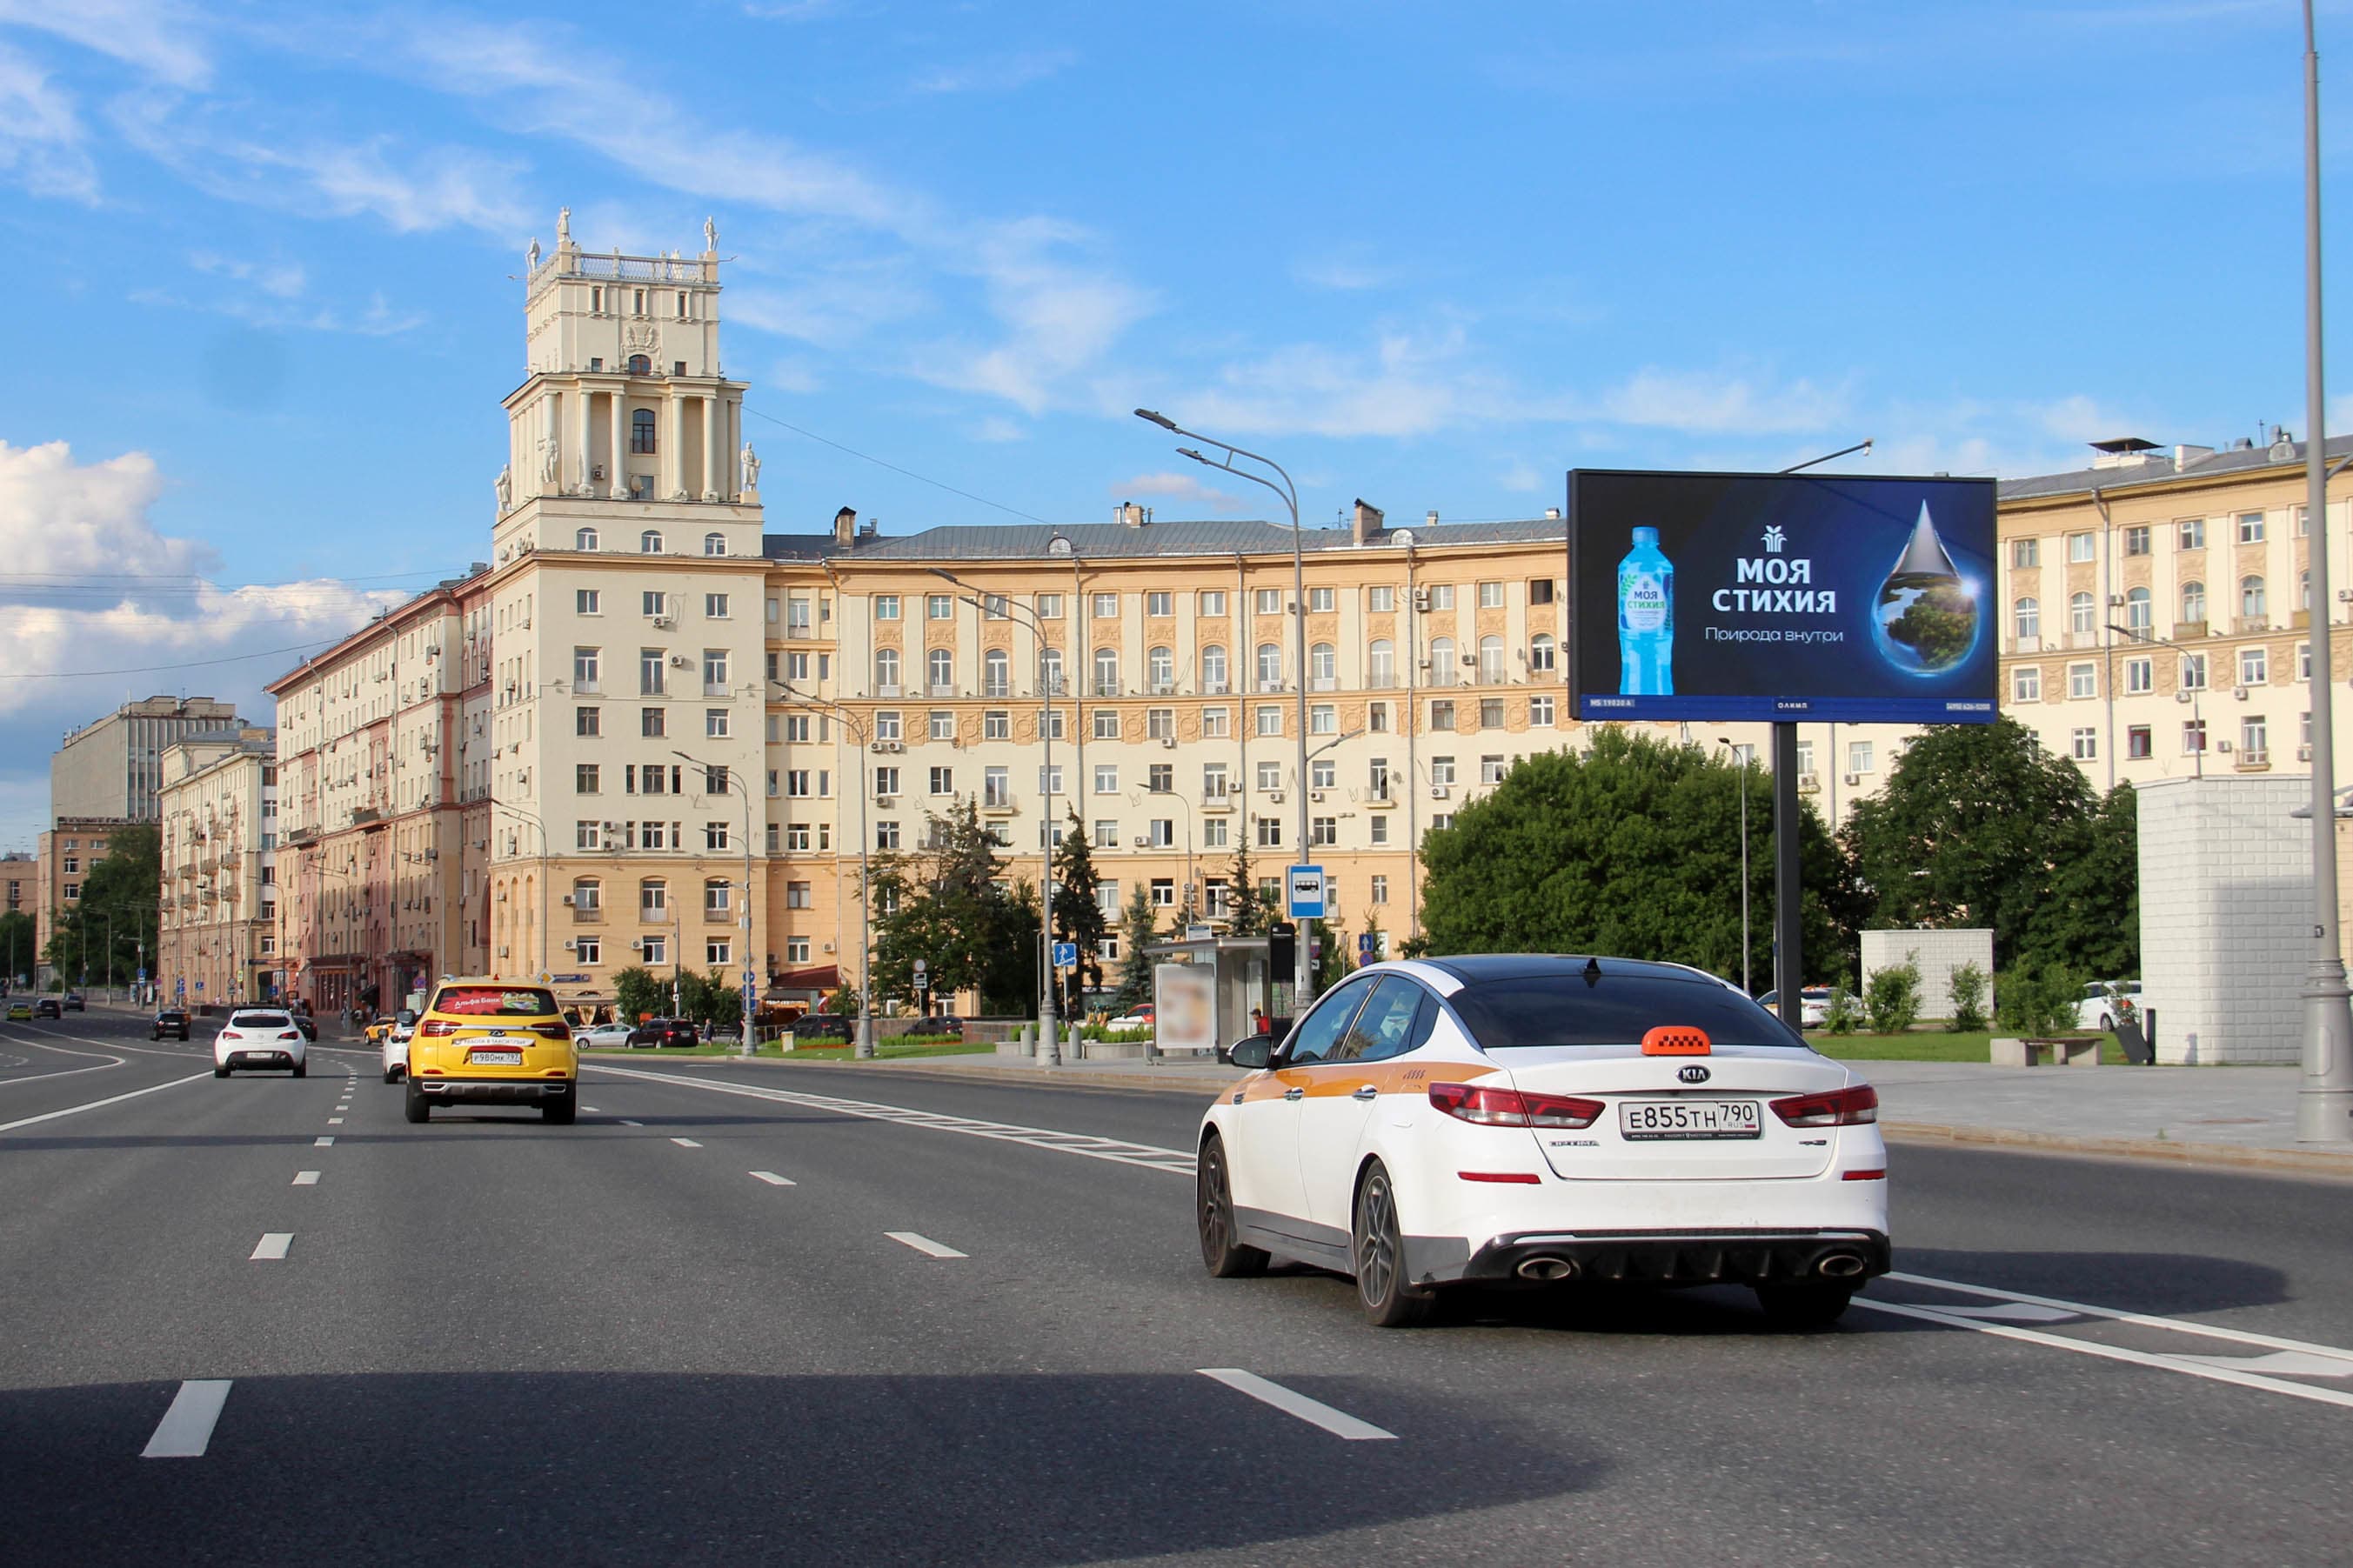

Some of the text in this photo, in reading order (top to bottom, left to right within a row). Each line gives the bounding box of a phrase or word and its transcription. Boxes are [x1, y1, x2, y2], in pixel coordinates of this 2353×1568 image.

[1736, 557, 1811, 584] МОЯ
[1634, 591, 1658, 600] МОЯ
[1712, 589, 1836, 613] СТИХИЯ
[1628, 600, 1666, 610] СТИХИЯ
[1705, 627, 1844, 644] Природа внутри
[454, 996, 501, 1010] Альфа Банк
[1682, 1069, 1707, 1079] KIA
[1719, 1104, 1754, 1121] 790
